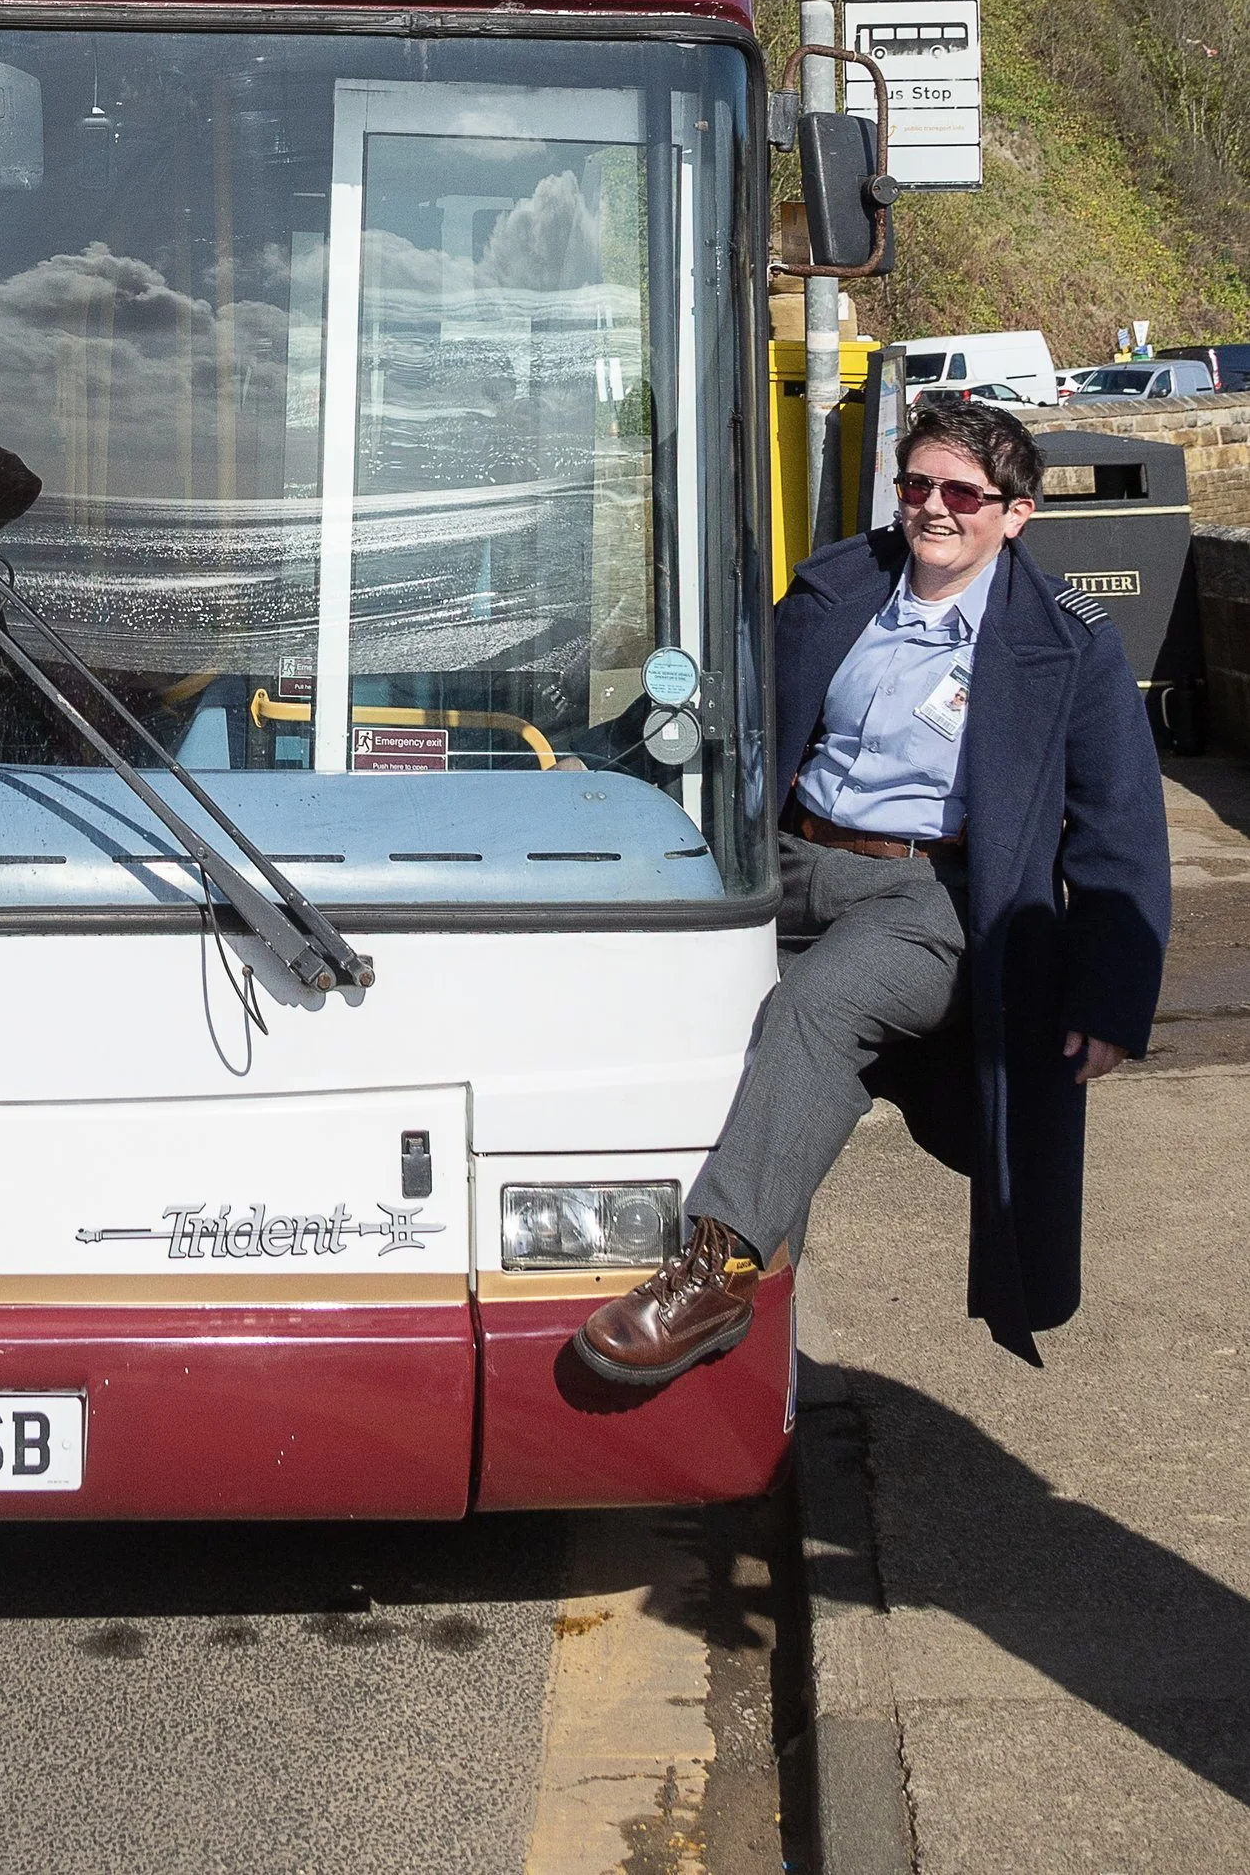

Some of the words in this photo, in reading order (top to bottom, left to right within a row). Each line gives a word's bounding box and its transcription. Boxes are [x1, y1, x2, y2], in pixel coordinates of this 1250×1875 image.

[912, 86, 952, 102] Stop
[1071, 576, 1134, 592] LITTER
[375, 736, 425, 748] Emergency
[426, 738, 442, 747] exit
[372, 762, 389, 770] Push
[389, 762, 404, 770] here
[162, 1202, 352, 1259] Trident
